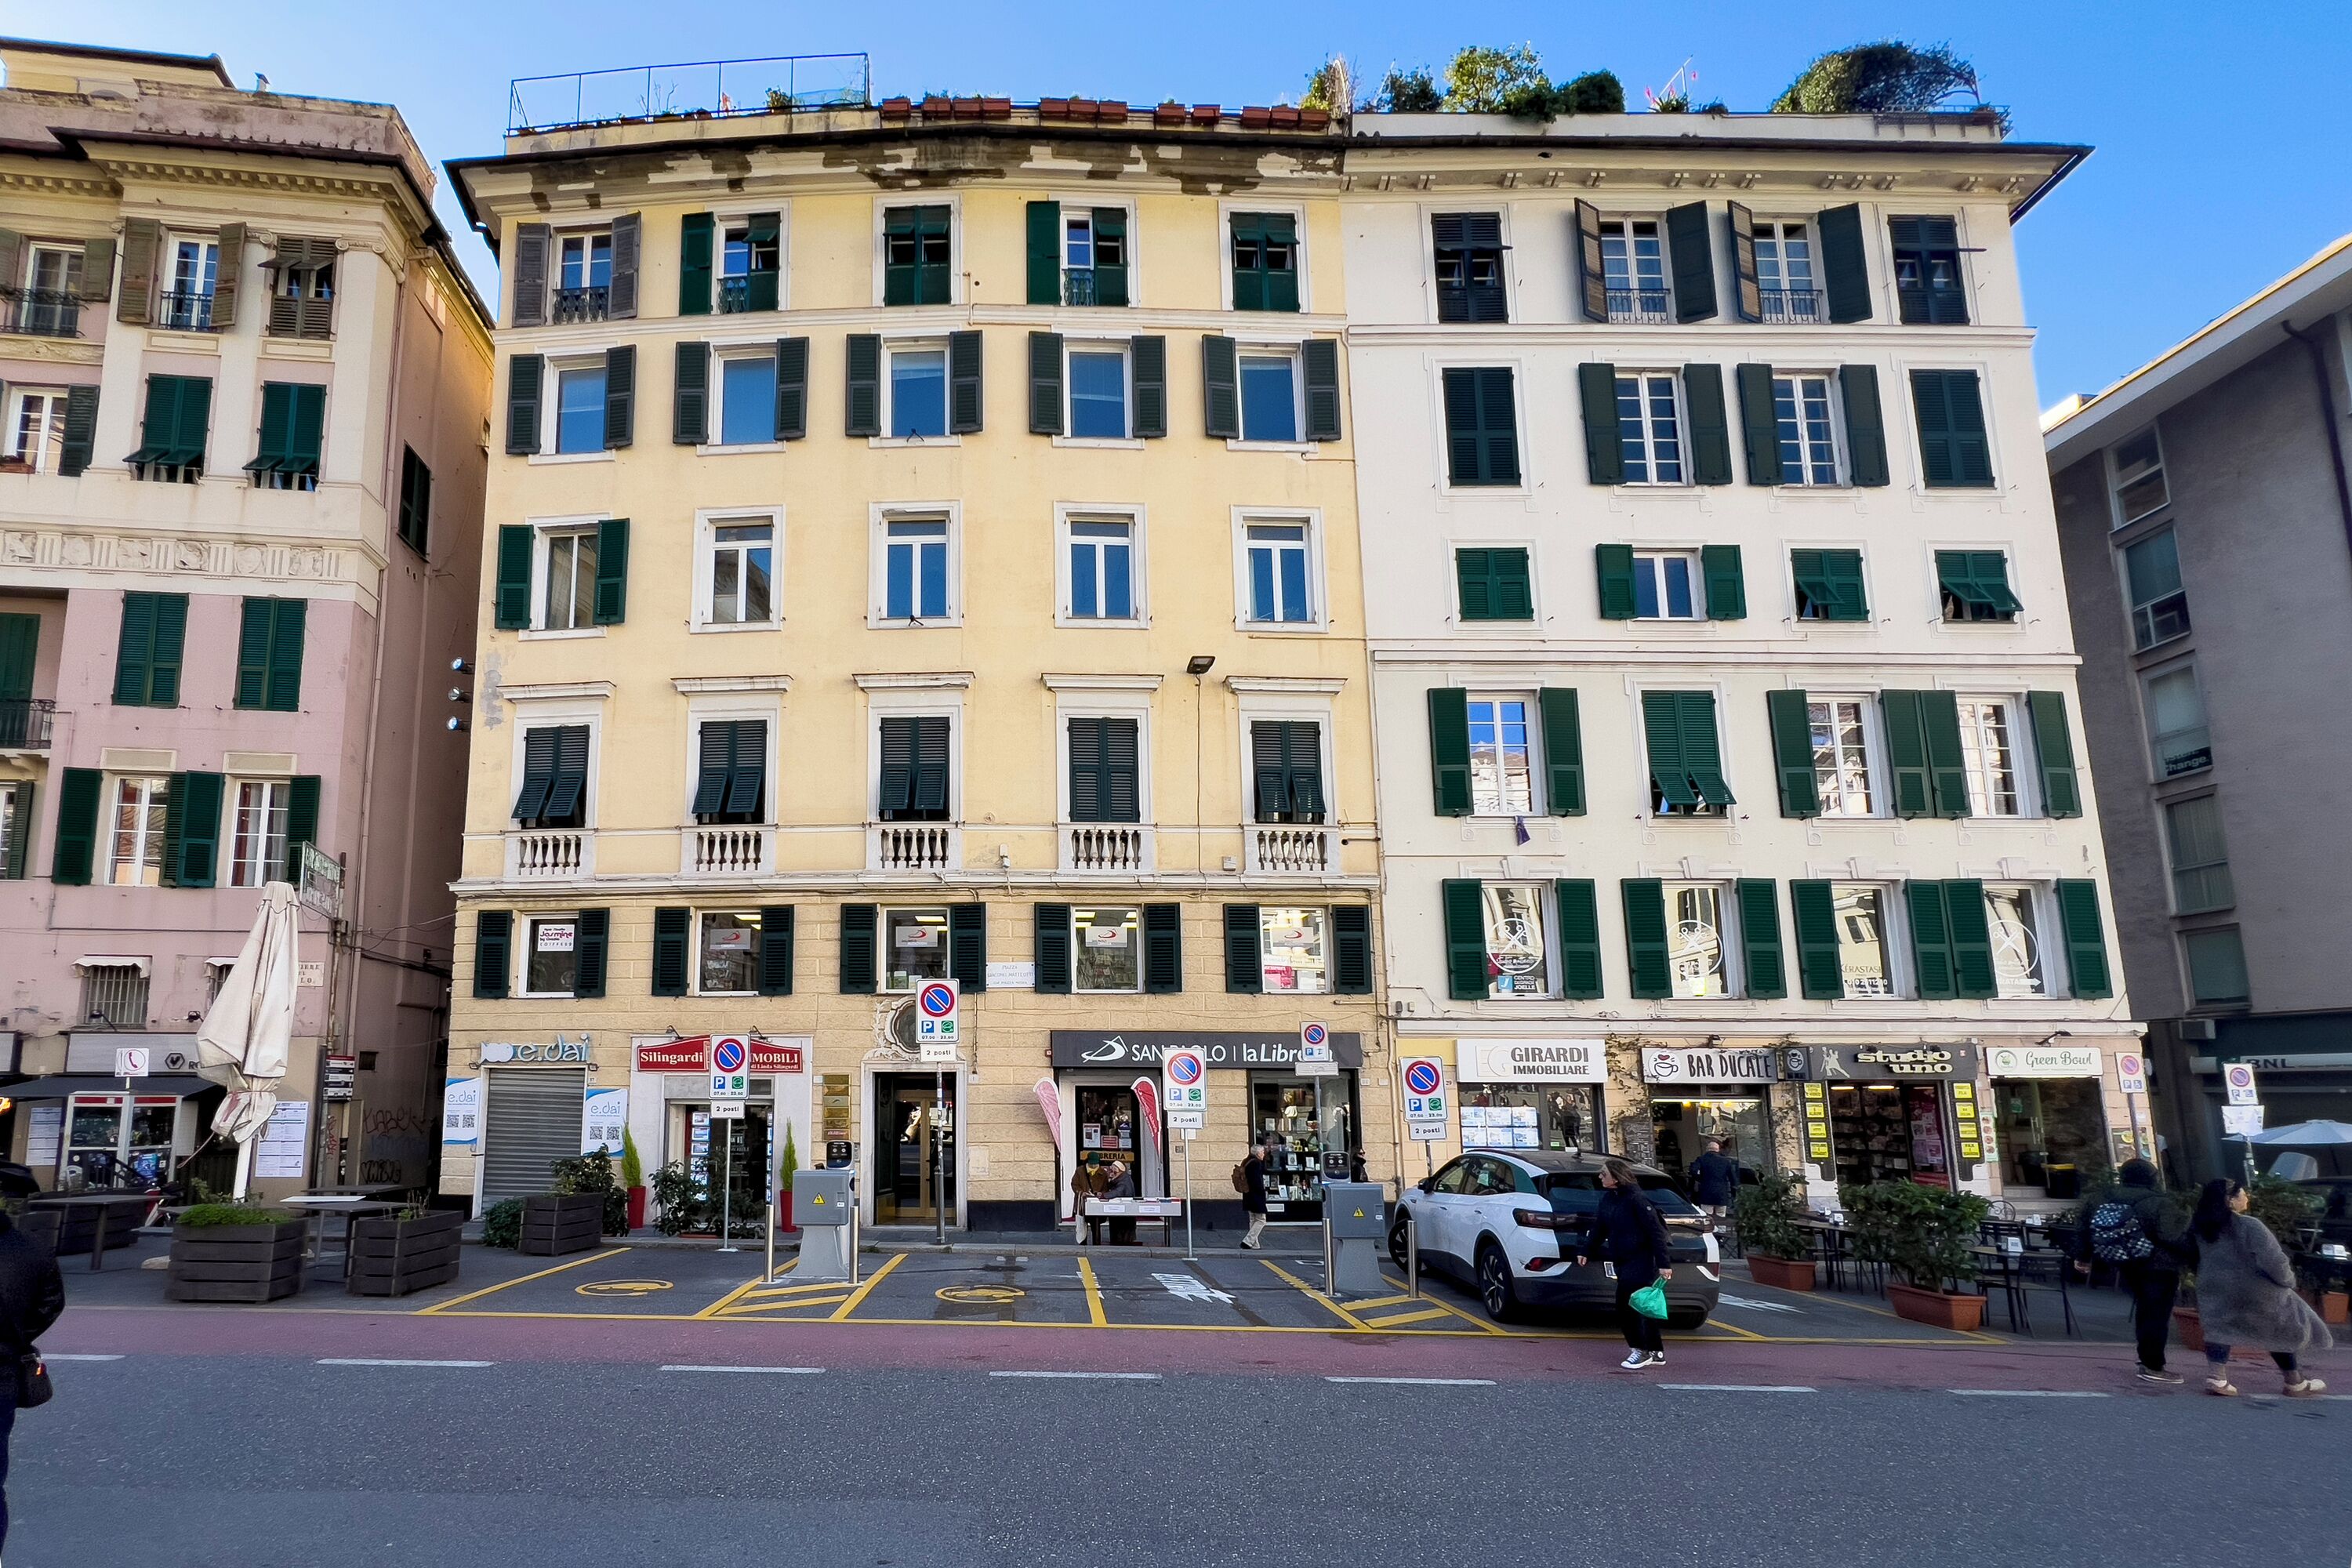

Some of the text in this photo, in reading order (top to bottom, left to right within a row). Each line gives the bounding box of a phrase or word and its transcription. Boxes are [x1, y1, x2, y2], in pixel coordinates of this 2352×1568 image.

[923, 1021, 933, 1033] P
[640, 1051, 703, 1065] Silingardi
[751, 1052, 798, 1063] MOBILI
[1131, 1044, 1163, 1062] SAN
[1510, 1047, 1589, 1062] GIRARDI
[1857, 1049, 1952, 1063] studio
[2025, 1051, 2092, 1068] Green Bowl
[2246, 1058, 2296, 1069] BNL
[1513, 1065, 1590, 1075] IMMOBILIARE
[1686, 1054, 1773, 1078] BAR DUCALE
[1889, 1063, 1954, 1073] uno
[715, 1076, 724, 1088] P
[447, 1090, 477, 1103] e.dai
[1171, 1088, 1180, 1100] P
[590, 1101, 621, 1114] e.dai
[1410, 1099, 1420, 1111] P
